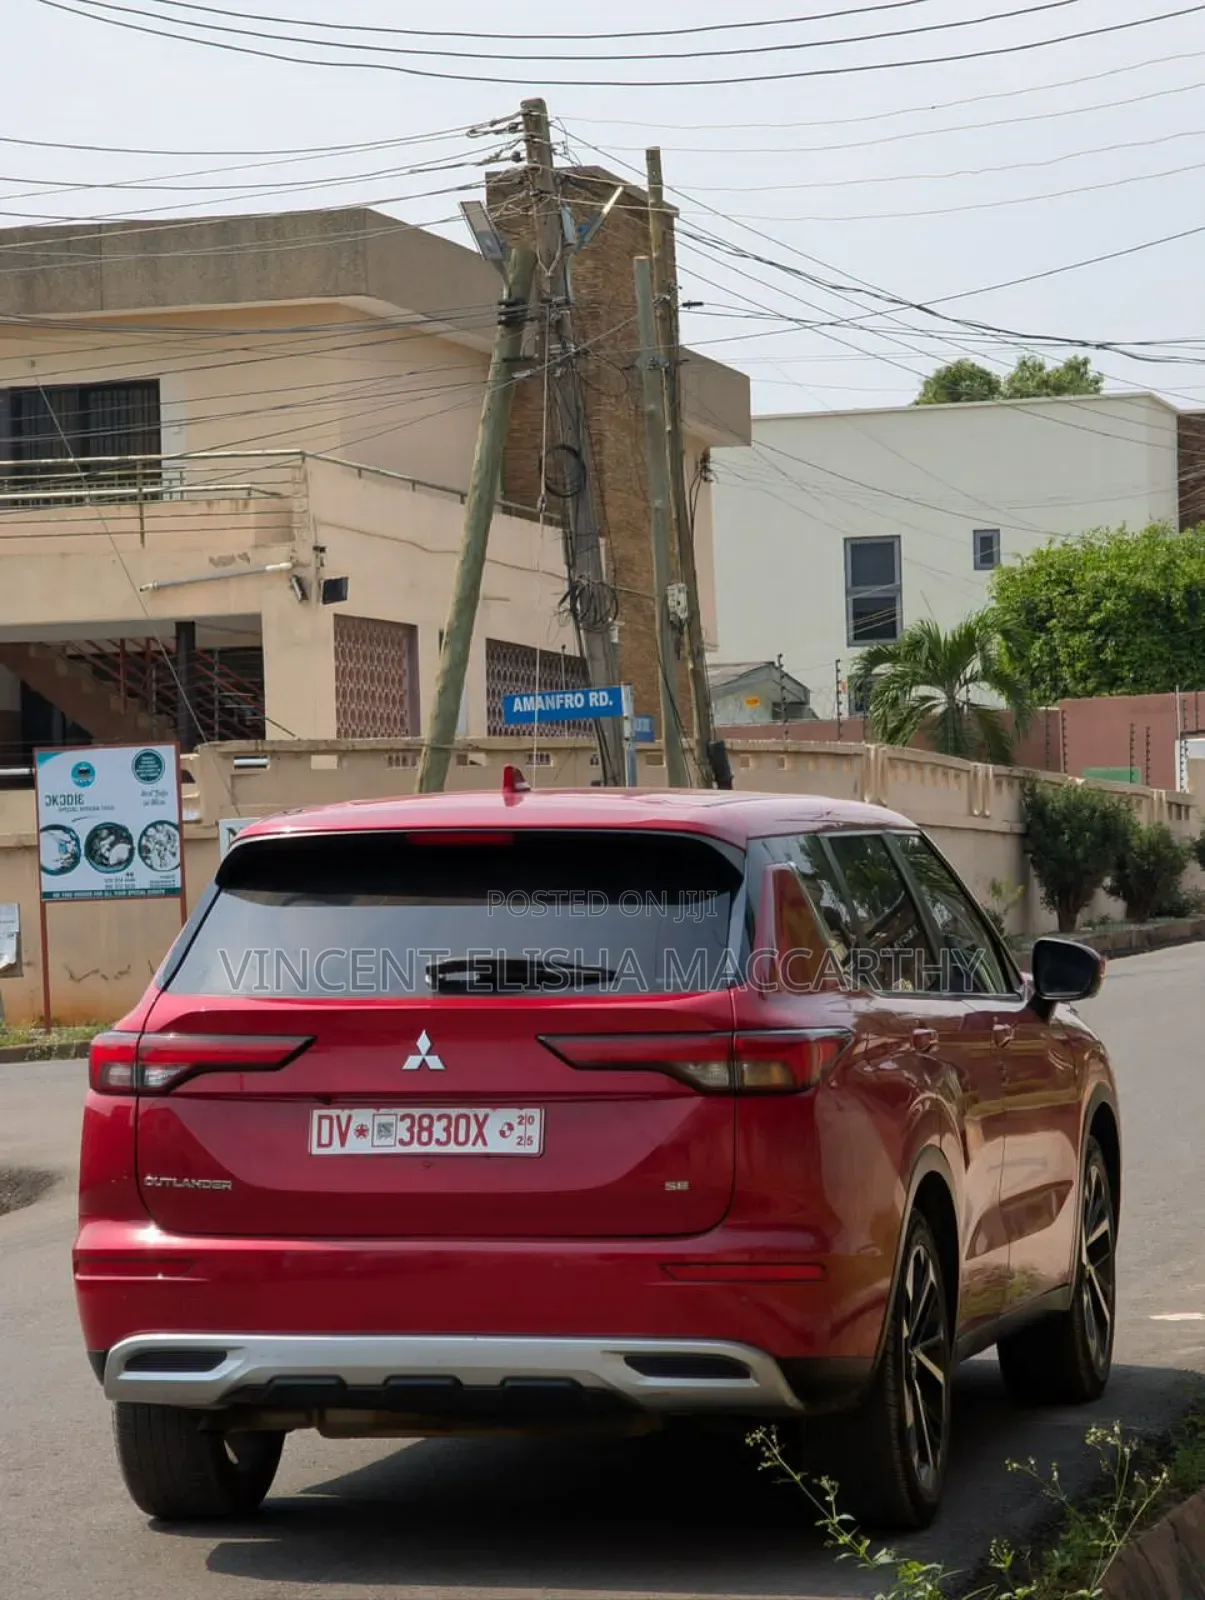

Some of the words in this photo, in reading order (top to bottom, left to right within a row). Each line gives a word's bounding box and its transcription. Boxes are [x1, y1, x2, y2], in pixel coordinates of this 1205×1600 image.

[513, 693, 584, 713] AMANFRO
[589, 691, 613, 708] RD.
[316, 1114, 352, 1149] DV
[398, 1112, 490, 1147] 3830X
[144, 1175, 232, 1190] OUTLANDER
[664, 1180, 689, 1191] SE
